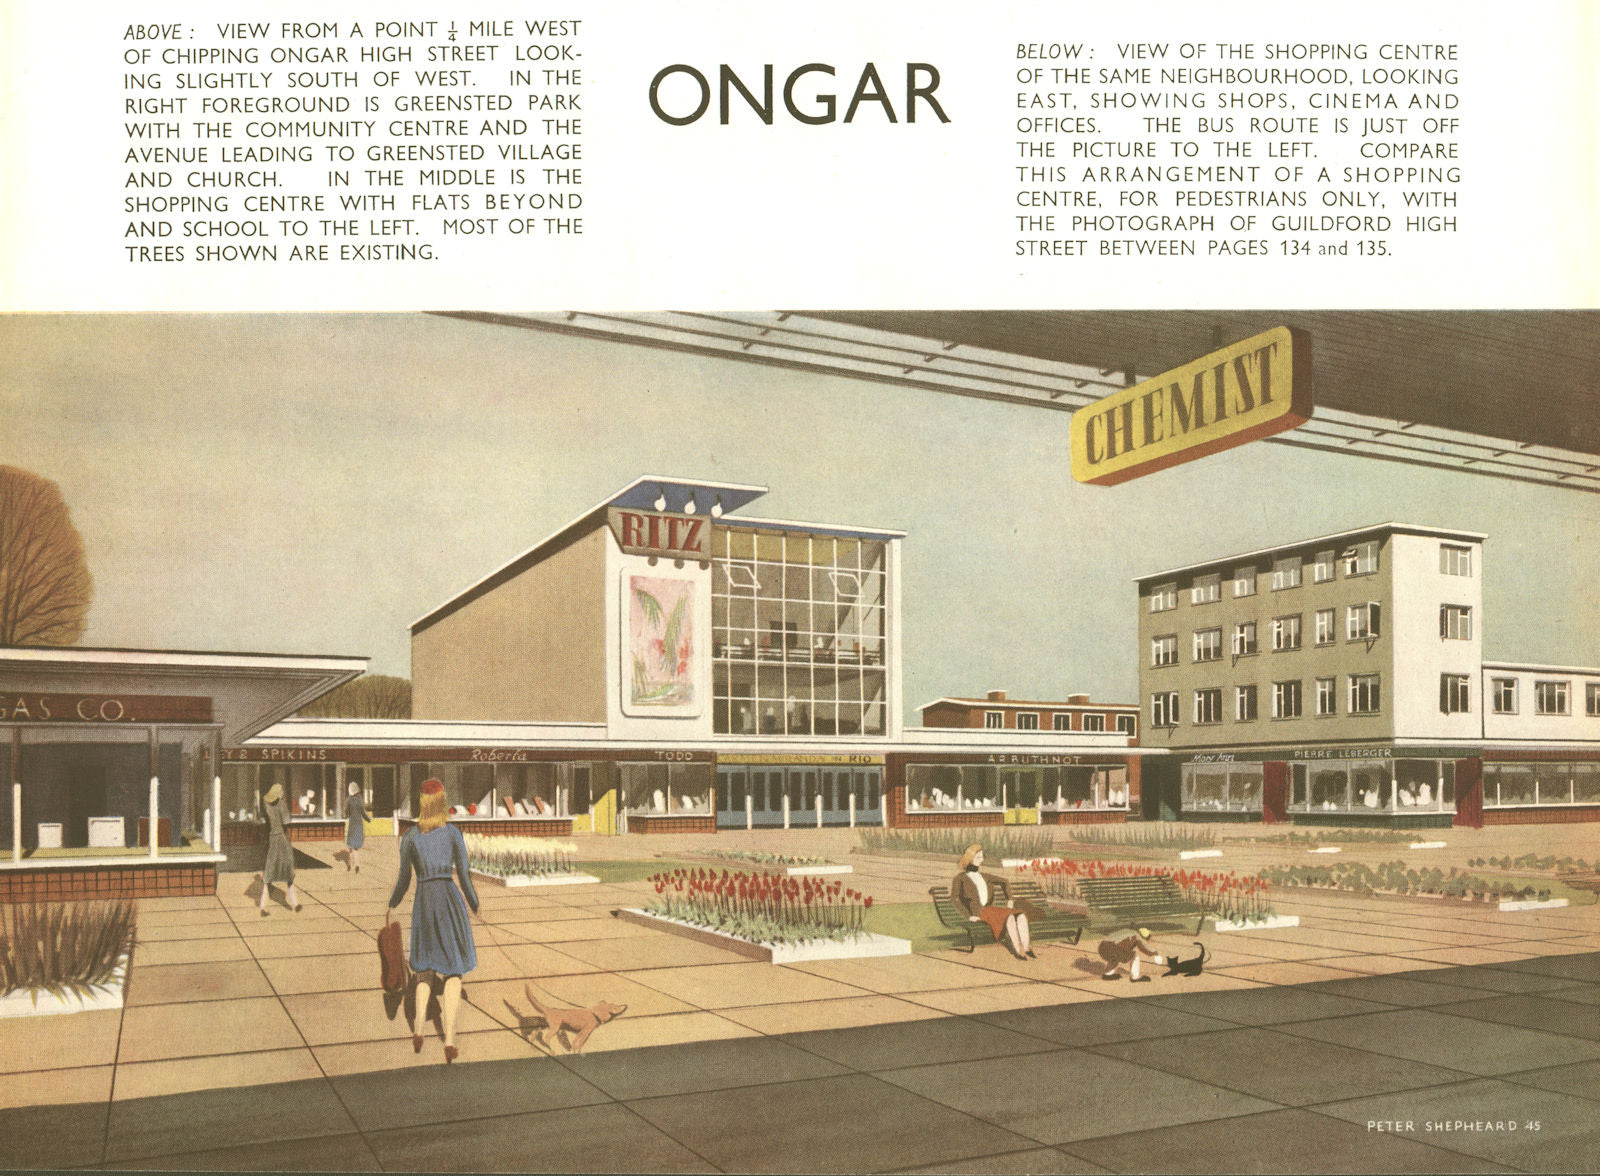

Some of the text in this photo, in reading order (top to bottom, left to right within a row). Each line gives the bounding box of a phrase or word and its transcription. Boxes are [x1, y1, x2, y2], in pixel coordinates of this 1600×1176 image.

[216, 22, 270, 39] VIEW
[282, 22, 338, 39] FROM
[349, 22, 364, 38] A
[375, 21, 439, 38] POINT
[469, 20, 514, 37] MILE
[524, 20, 582, 37] WEST
[124, 44, 582, 65] OF CHIPPING ONGAR HIGH STREET LOOK-
[1117, 43, 1169, 59] VIEW
[1179, 42, 1207, 59] OF
[1215, 43, 1254, 60] THE
[1265, 43, 1368, 60] SHOPPING
[1379, 44, 1458, 61] CENTRE
[124, 69, 582, 90] ING SLIGHTLY SOUTH OF WEST. IN THE
[1016, 67, 1458, 86] OF THE SAME NEIGHBOURHOOD, LOOKING
[648, 62, 952, 127] ONGAR
[1017, 92, 1459, 110] EAST, SHOWING SHOPS, CINEMA AND
[125, 94, 582, 115] RIGHT FOREGROUND IS GREENSTED PARK
[124, 119, 582, 139] WITH THE COMMUNITY CENTRE AND THE
[1016, 116, 1460, 138] OFFICES. THE BUS ROUTE IS JUST OFF
[124, 143, 582, 164] AVENUE LEADING TO GREENSTED VILLAGE
[1016, 141, 1458, 160] THE PICTURE TO THE LEFT. COMPARE
[124, 168, 582, 189] AND CHURCH. IN THE MIDDLE IS THE
[1015, 165, 1461, 183] THIS ARRANGEMENT OF A SHOPPING
[124, 193, 583, 213] SHOPPING CENTRE WITH FLATS BEYOND
[1016, 190, 1457, 209] CENTRE, FOR PEDESTRIANS ONLY, WITH
[124, 217, 583, 238] AND SCHOOL TO THE LEFT. MOST OF THE
[1015, 215, 1457, 232] THE PHOTOGRAPH OF GUILDFORD HIGH
[124, 243, 439, 263] TREES SHOWN ARE EXISTING.
[1015, 239, 1392, 256] STREET BETWEEN PAGES 134 and 135.
[1085, 341, 1278, 466] CHEMIST
[617, 511, 703, 553] RITZ
[0, 696, 136, 721] AS CO.
[261, 748, 328, 761] SPIKINS
[469, 749, 528, 762] Roberta
[654, 750, 694, 761] TODD
[849, 754, 872, 764] RIO
[1294, 750, 1333, 760] PIERRE
[1366, 1119, 1416, 1133] PETER
[1425, 1119, 1518, 1132] SHEPHEARD
